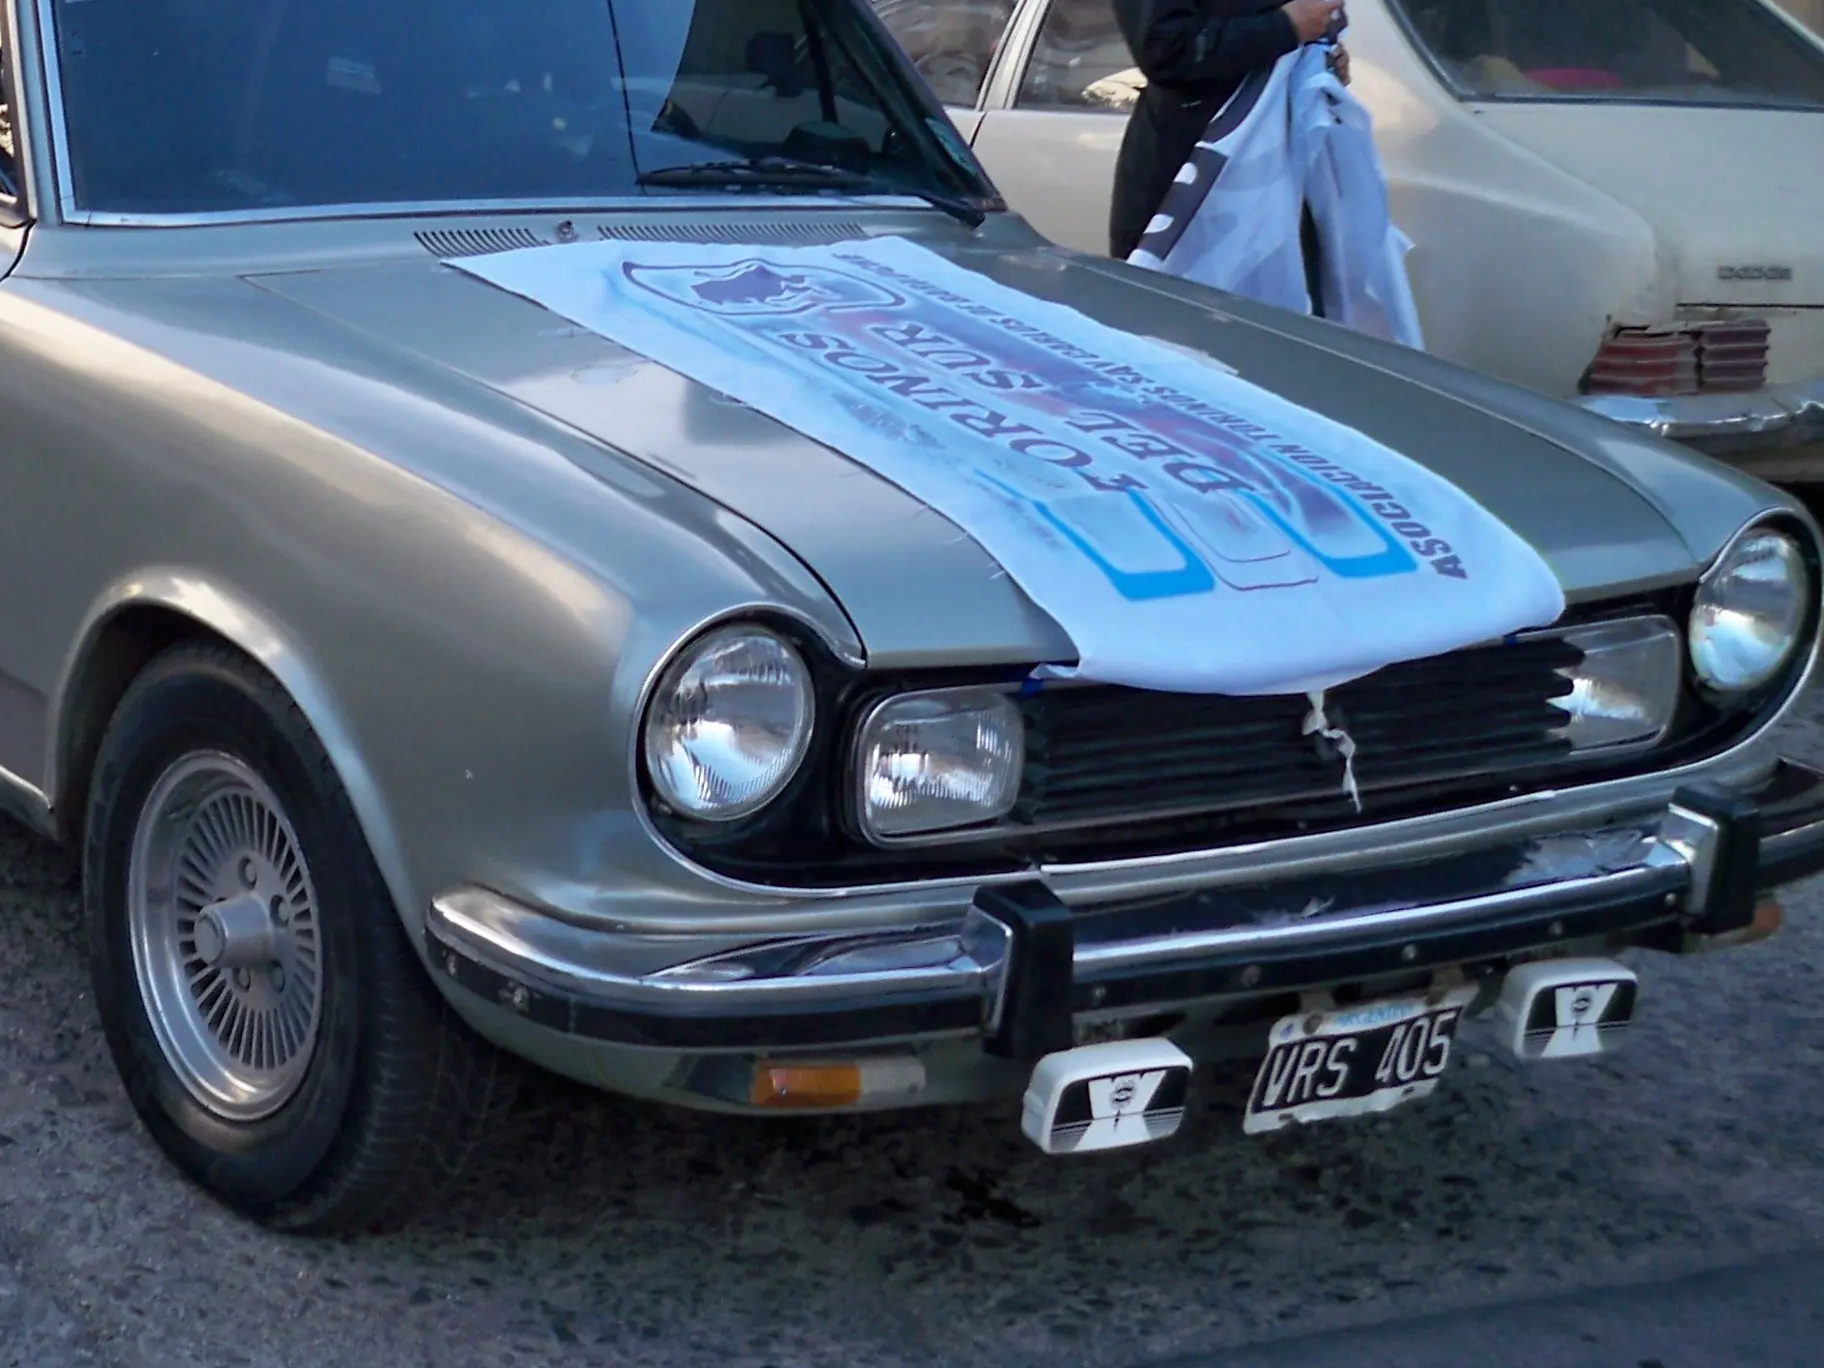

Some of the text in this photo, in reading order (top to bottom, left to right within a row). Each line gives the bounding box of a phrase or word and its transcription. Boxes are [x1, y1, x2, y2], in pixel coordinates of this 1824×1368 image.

[870, 322, 1256, 494] DEL SUR
[1273, 443, 1468, 580] ASOCIACION
[1263, 1010, 1457, 1107] VRS 405
